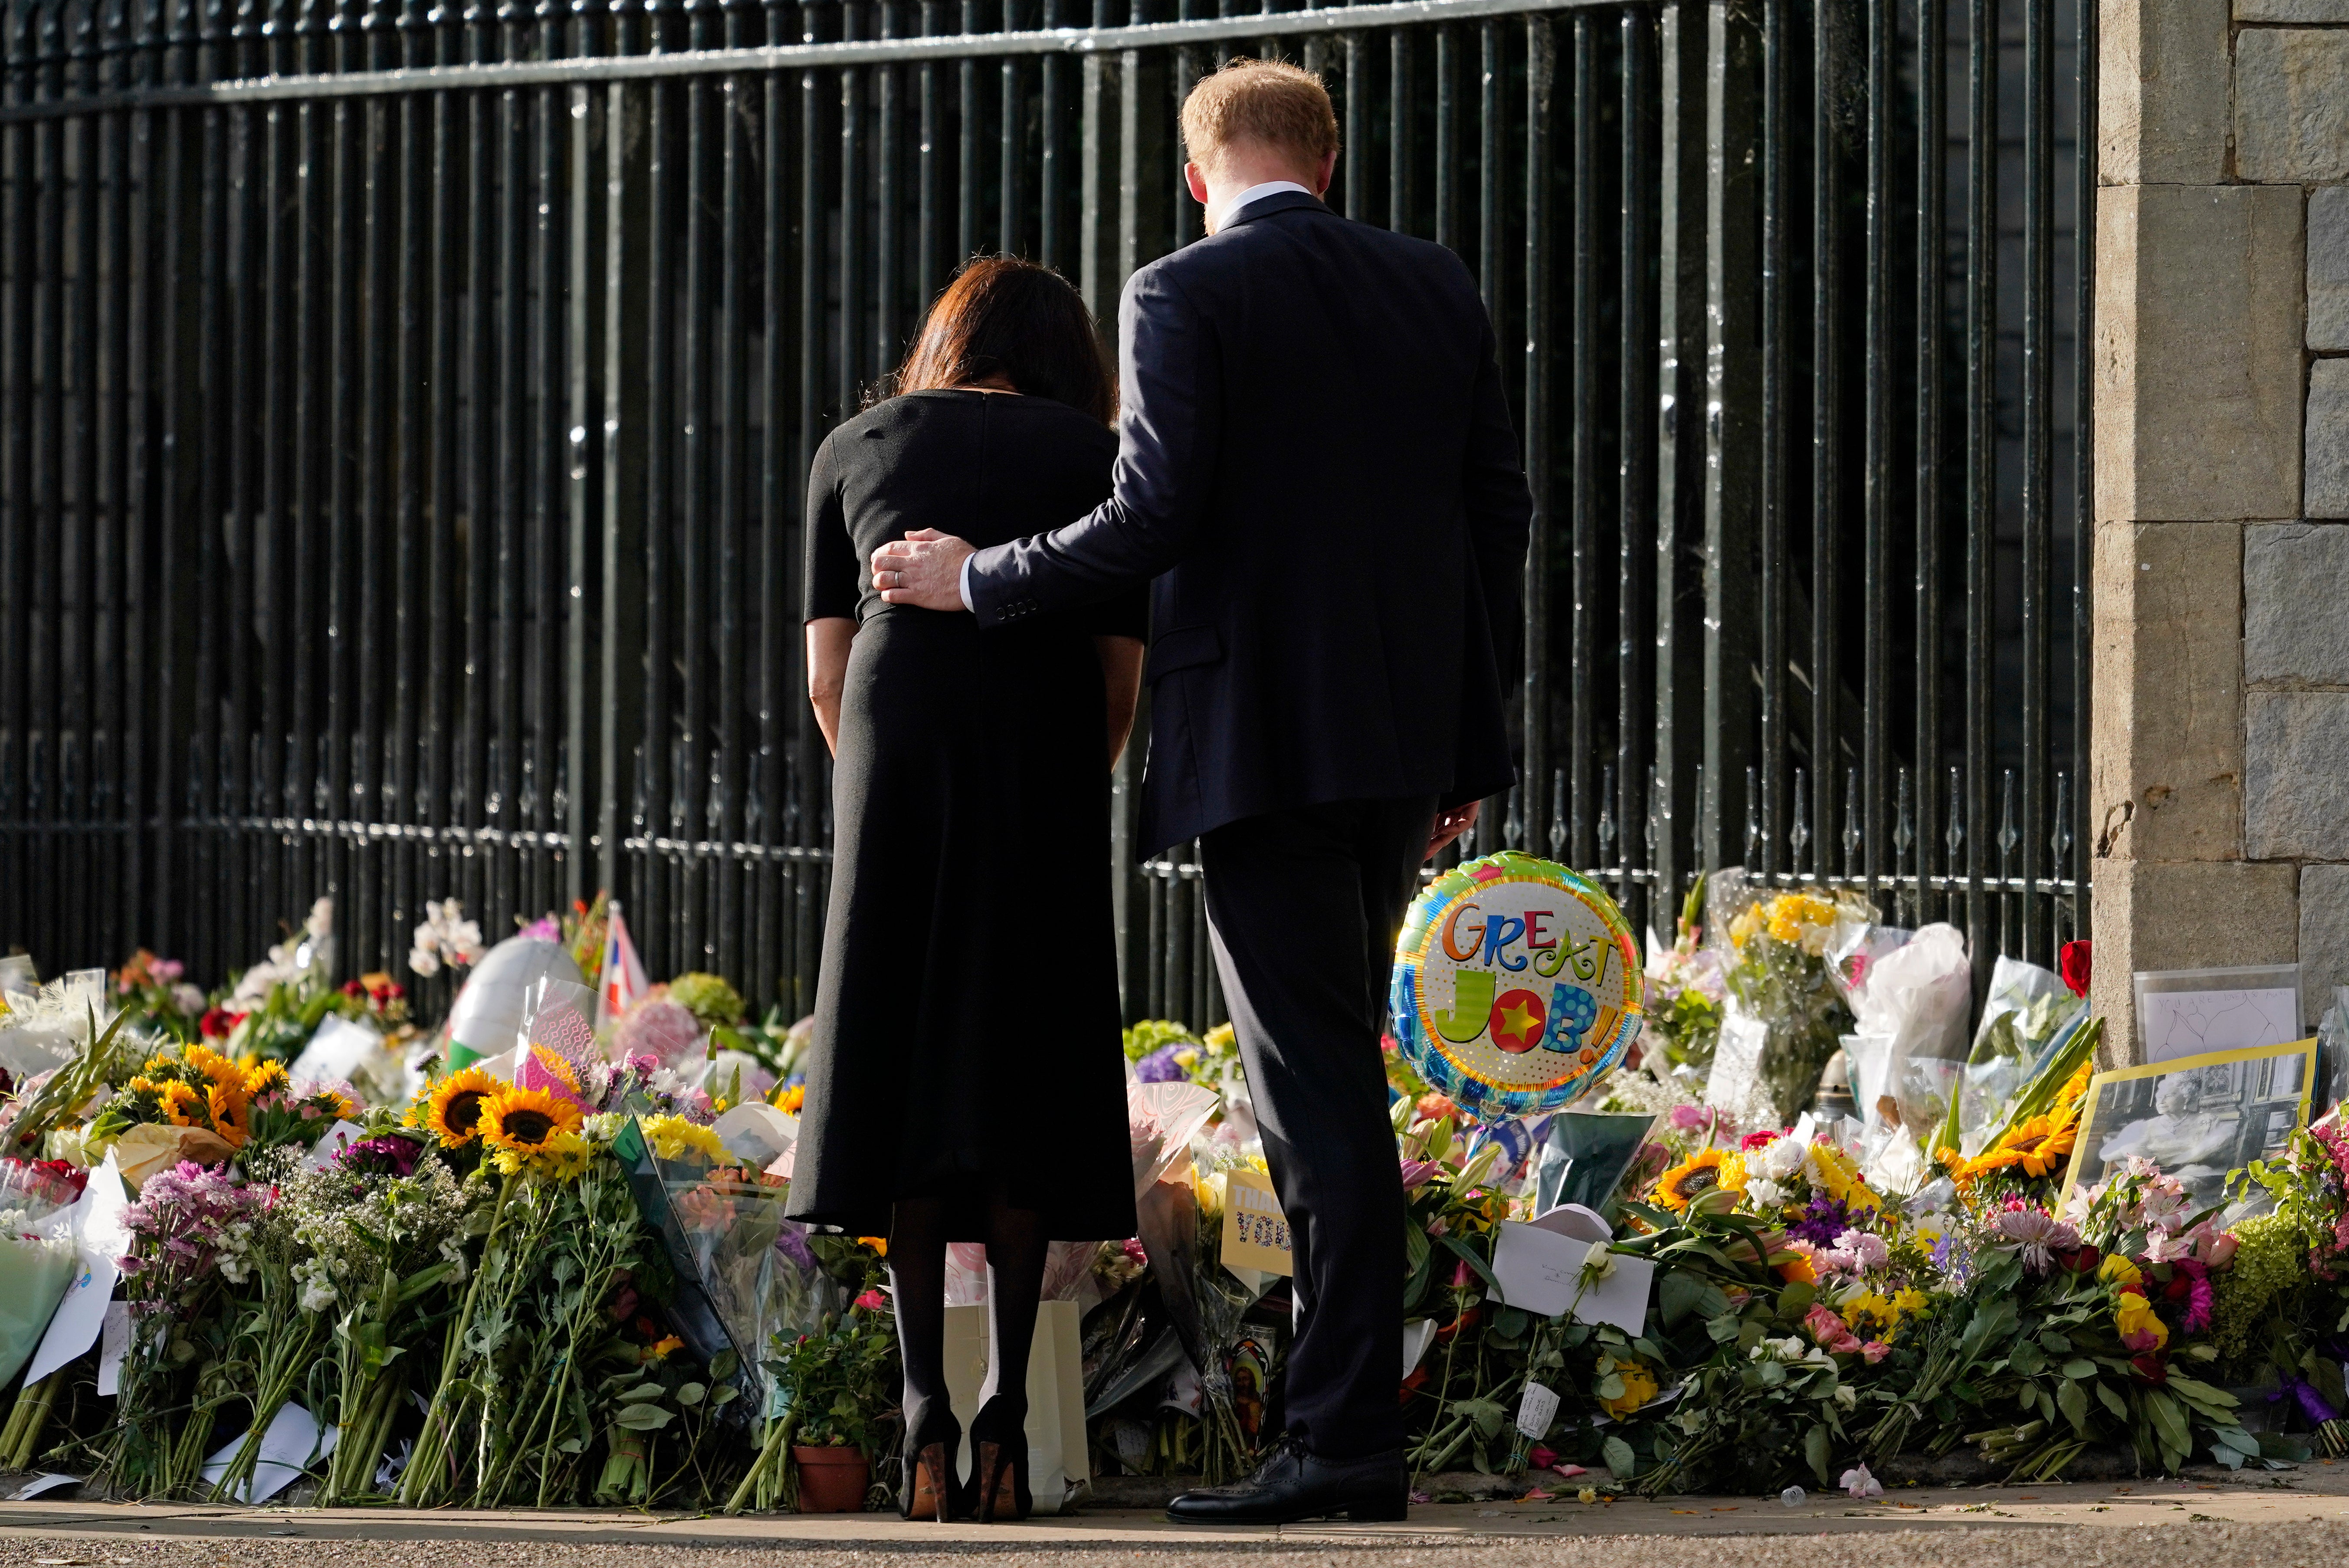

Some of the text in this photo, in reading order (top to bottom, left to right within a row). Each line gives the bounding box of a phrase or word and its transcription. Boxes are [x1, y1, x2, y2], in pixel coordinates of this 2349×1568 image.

[1441, 903, 1618, 987] GREAT
[1435, 969, 1618, 1065] JOB!
[2188, 995, 2212, 1008] ARE
[1233, 1184, 1284, 1215] THAN
[1237, 1211, 1292, 1251] YOU
